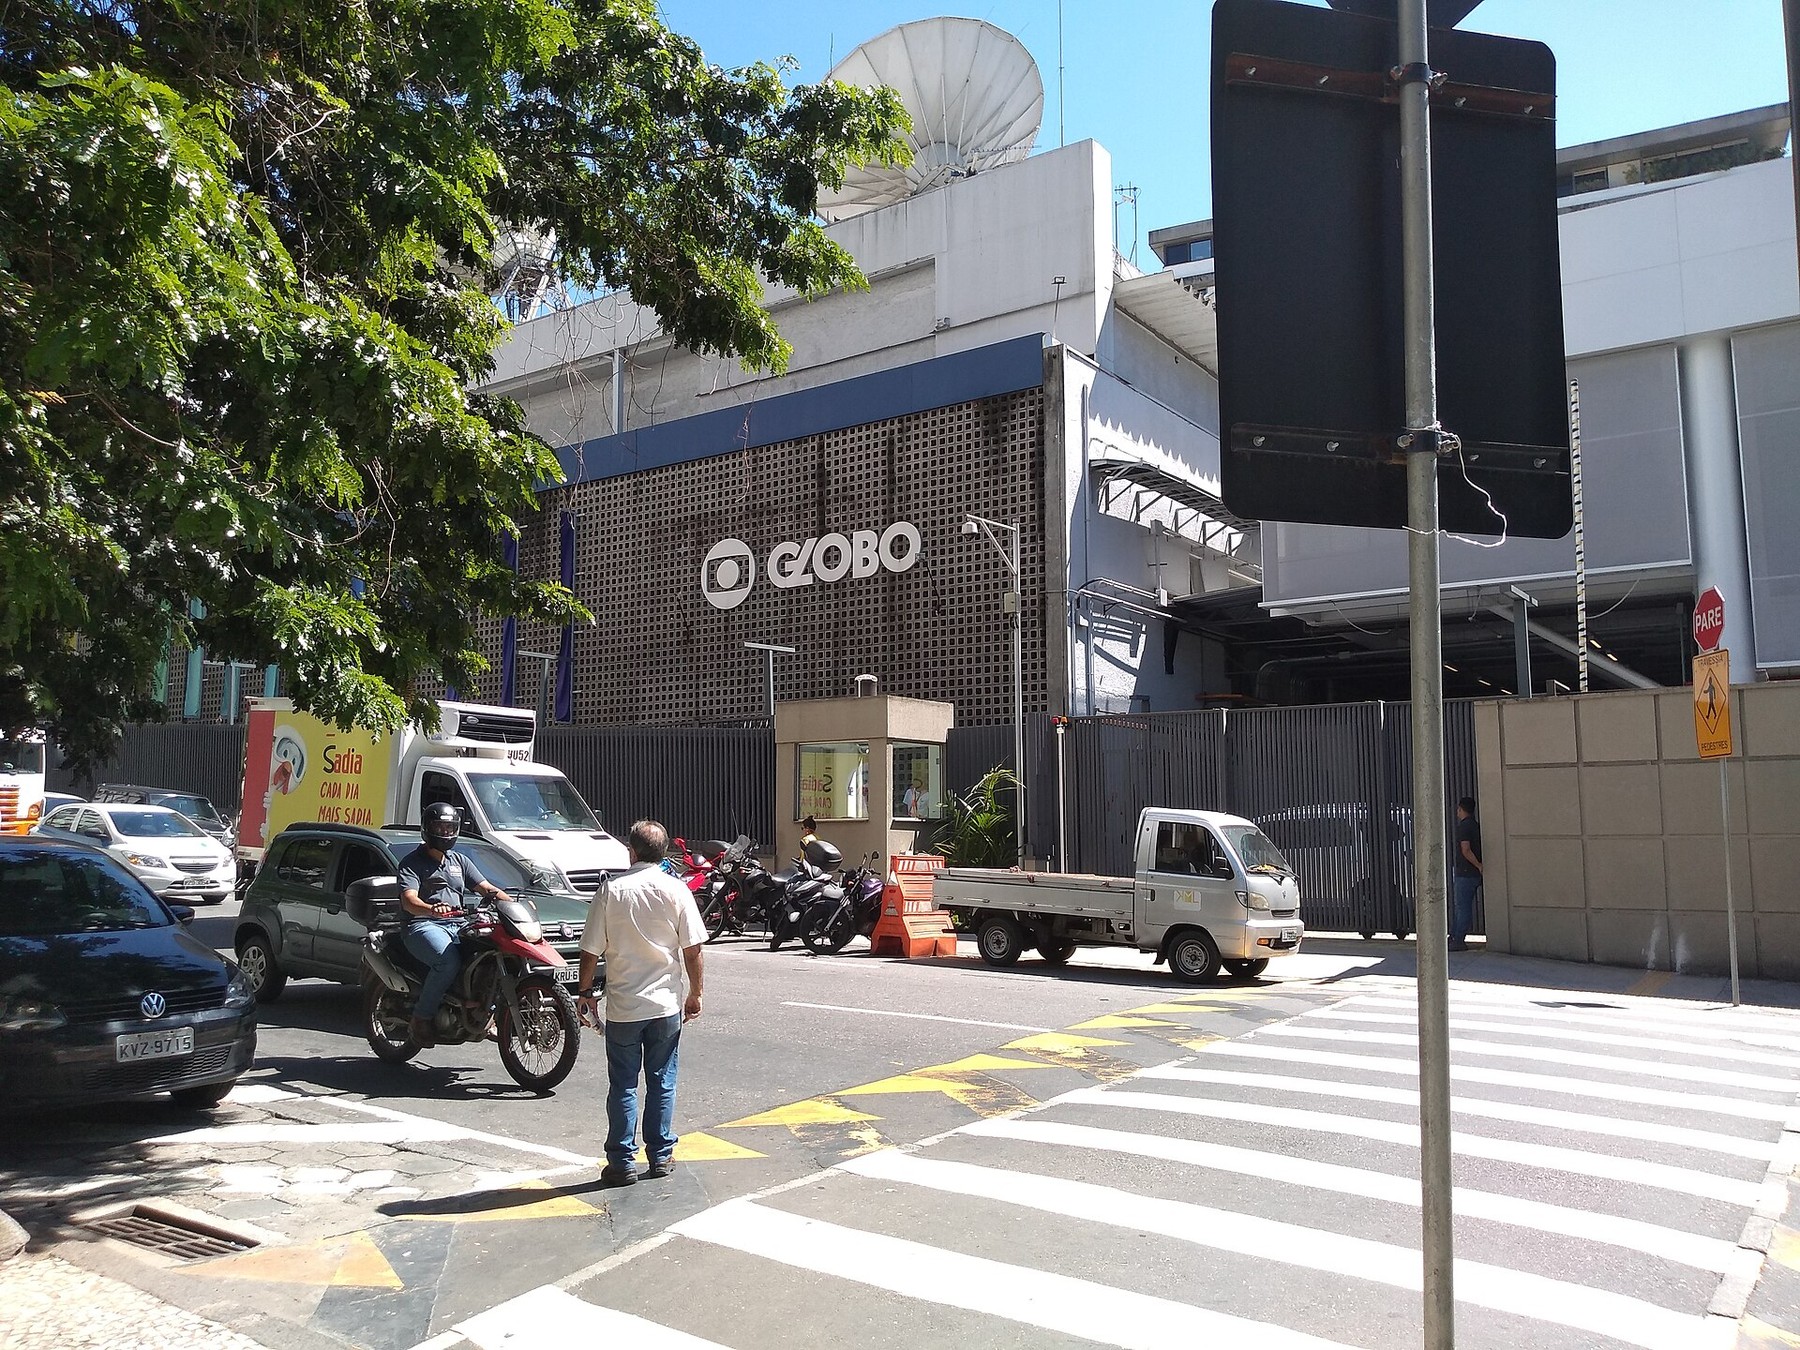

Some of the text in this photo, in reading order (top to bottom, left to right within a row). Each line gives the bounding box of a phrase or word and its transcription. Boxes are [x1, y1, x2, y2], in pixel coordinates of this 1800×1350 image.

[767, 521, 922, 589] GLOBO
[1695, 606, 1722, 634] PARE
[1701, 740, 1728, 751] PEDESTRES
[323, 745, 362, 774] Sadia
[320, 781, 359, 800] CADA DIA
[318, 805, 373, 826] MAIS SADIA.
